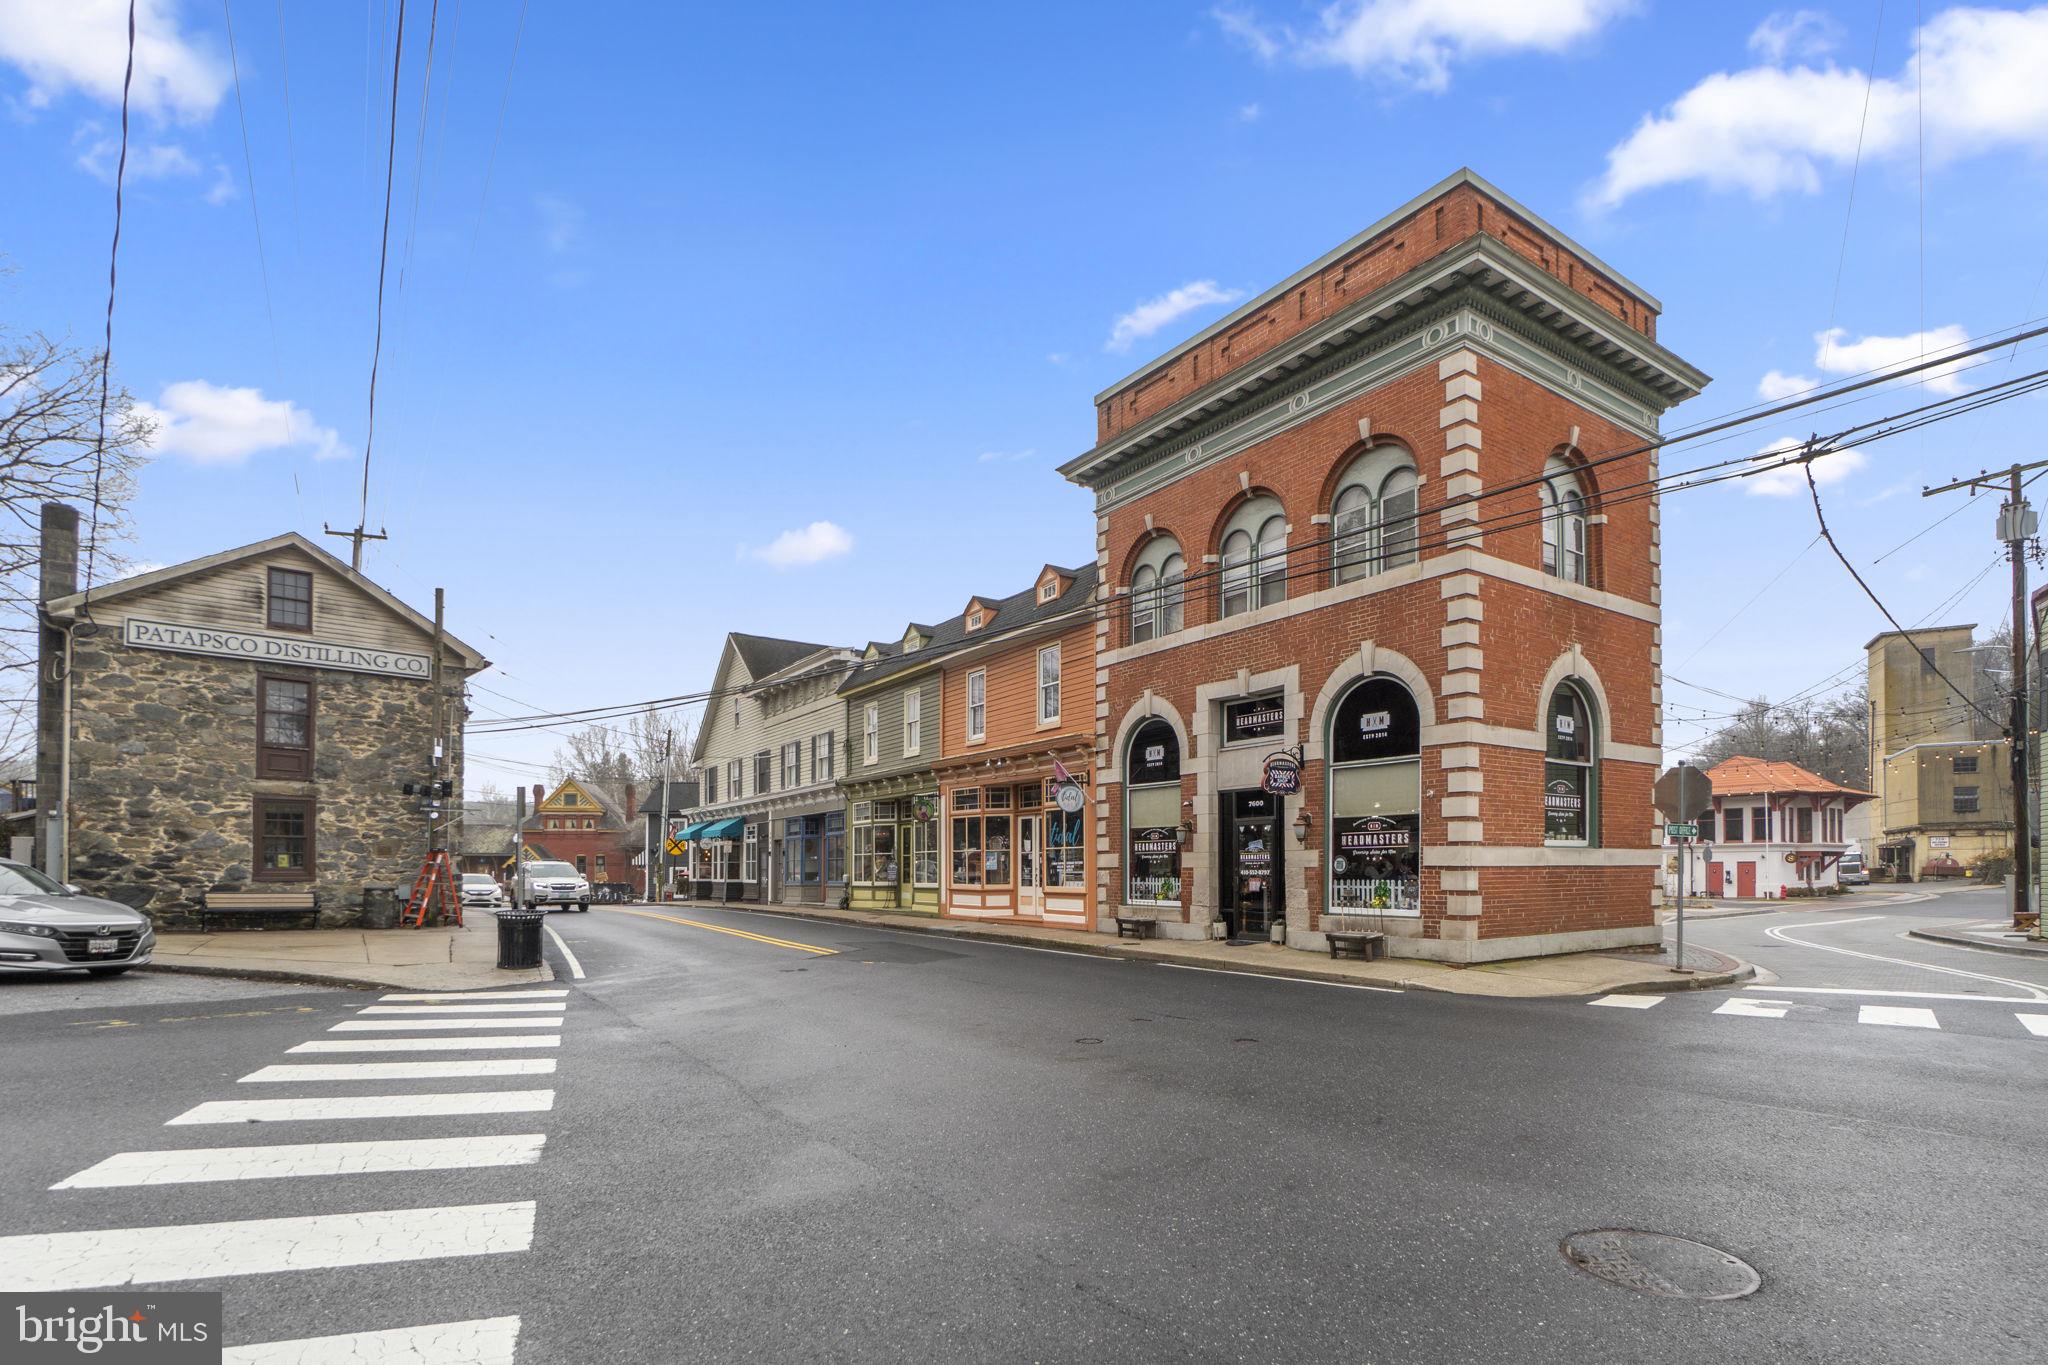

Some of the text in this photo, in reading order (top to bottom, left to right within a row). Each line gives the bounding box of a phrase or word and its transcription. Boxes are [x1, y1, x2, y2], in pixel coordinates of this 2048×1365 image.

[135, 624, 426, 673] PATAPSCO DISTILLING CO.
[1236, 711, 1283, 726] HEADMASTERS
[1545, 796, 1581, 808] EADMASTERS
[1050, 819, 1081, 848] tidal
[1341, 833, 1410, 846] HEADMASTERS
[1134, 842, 1176, 852] HEADMASTERS
